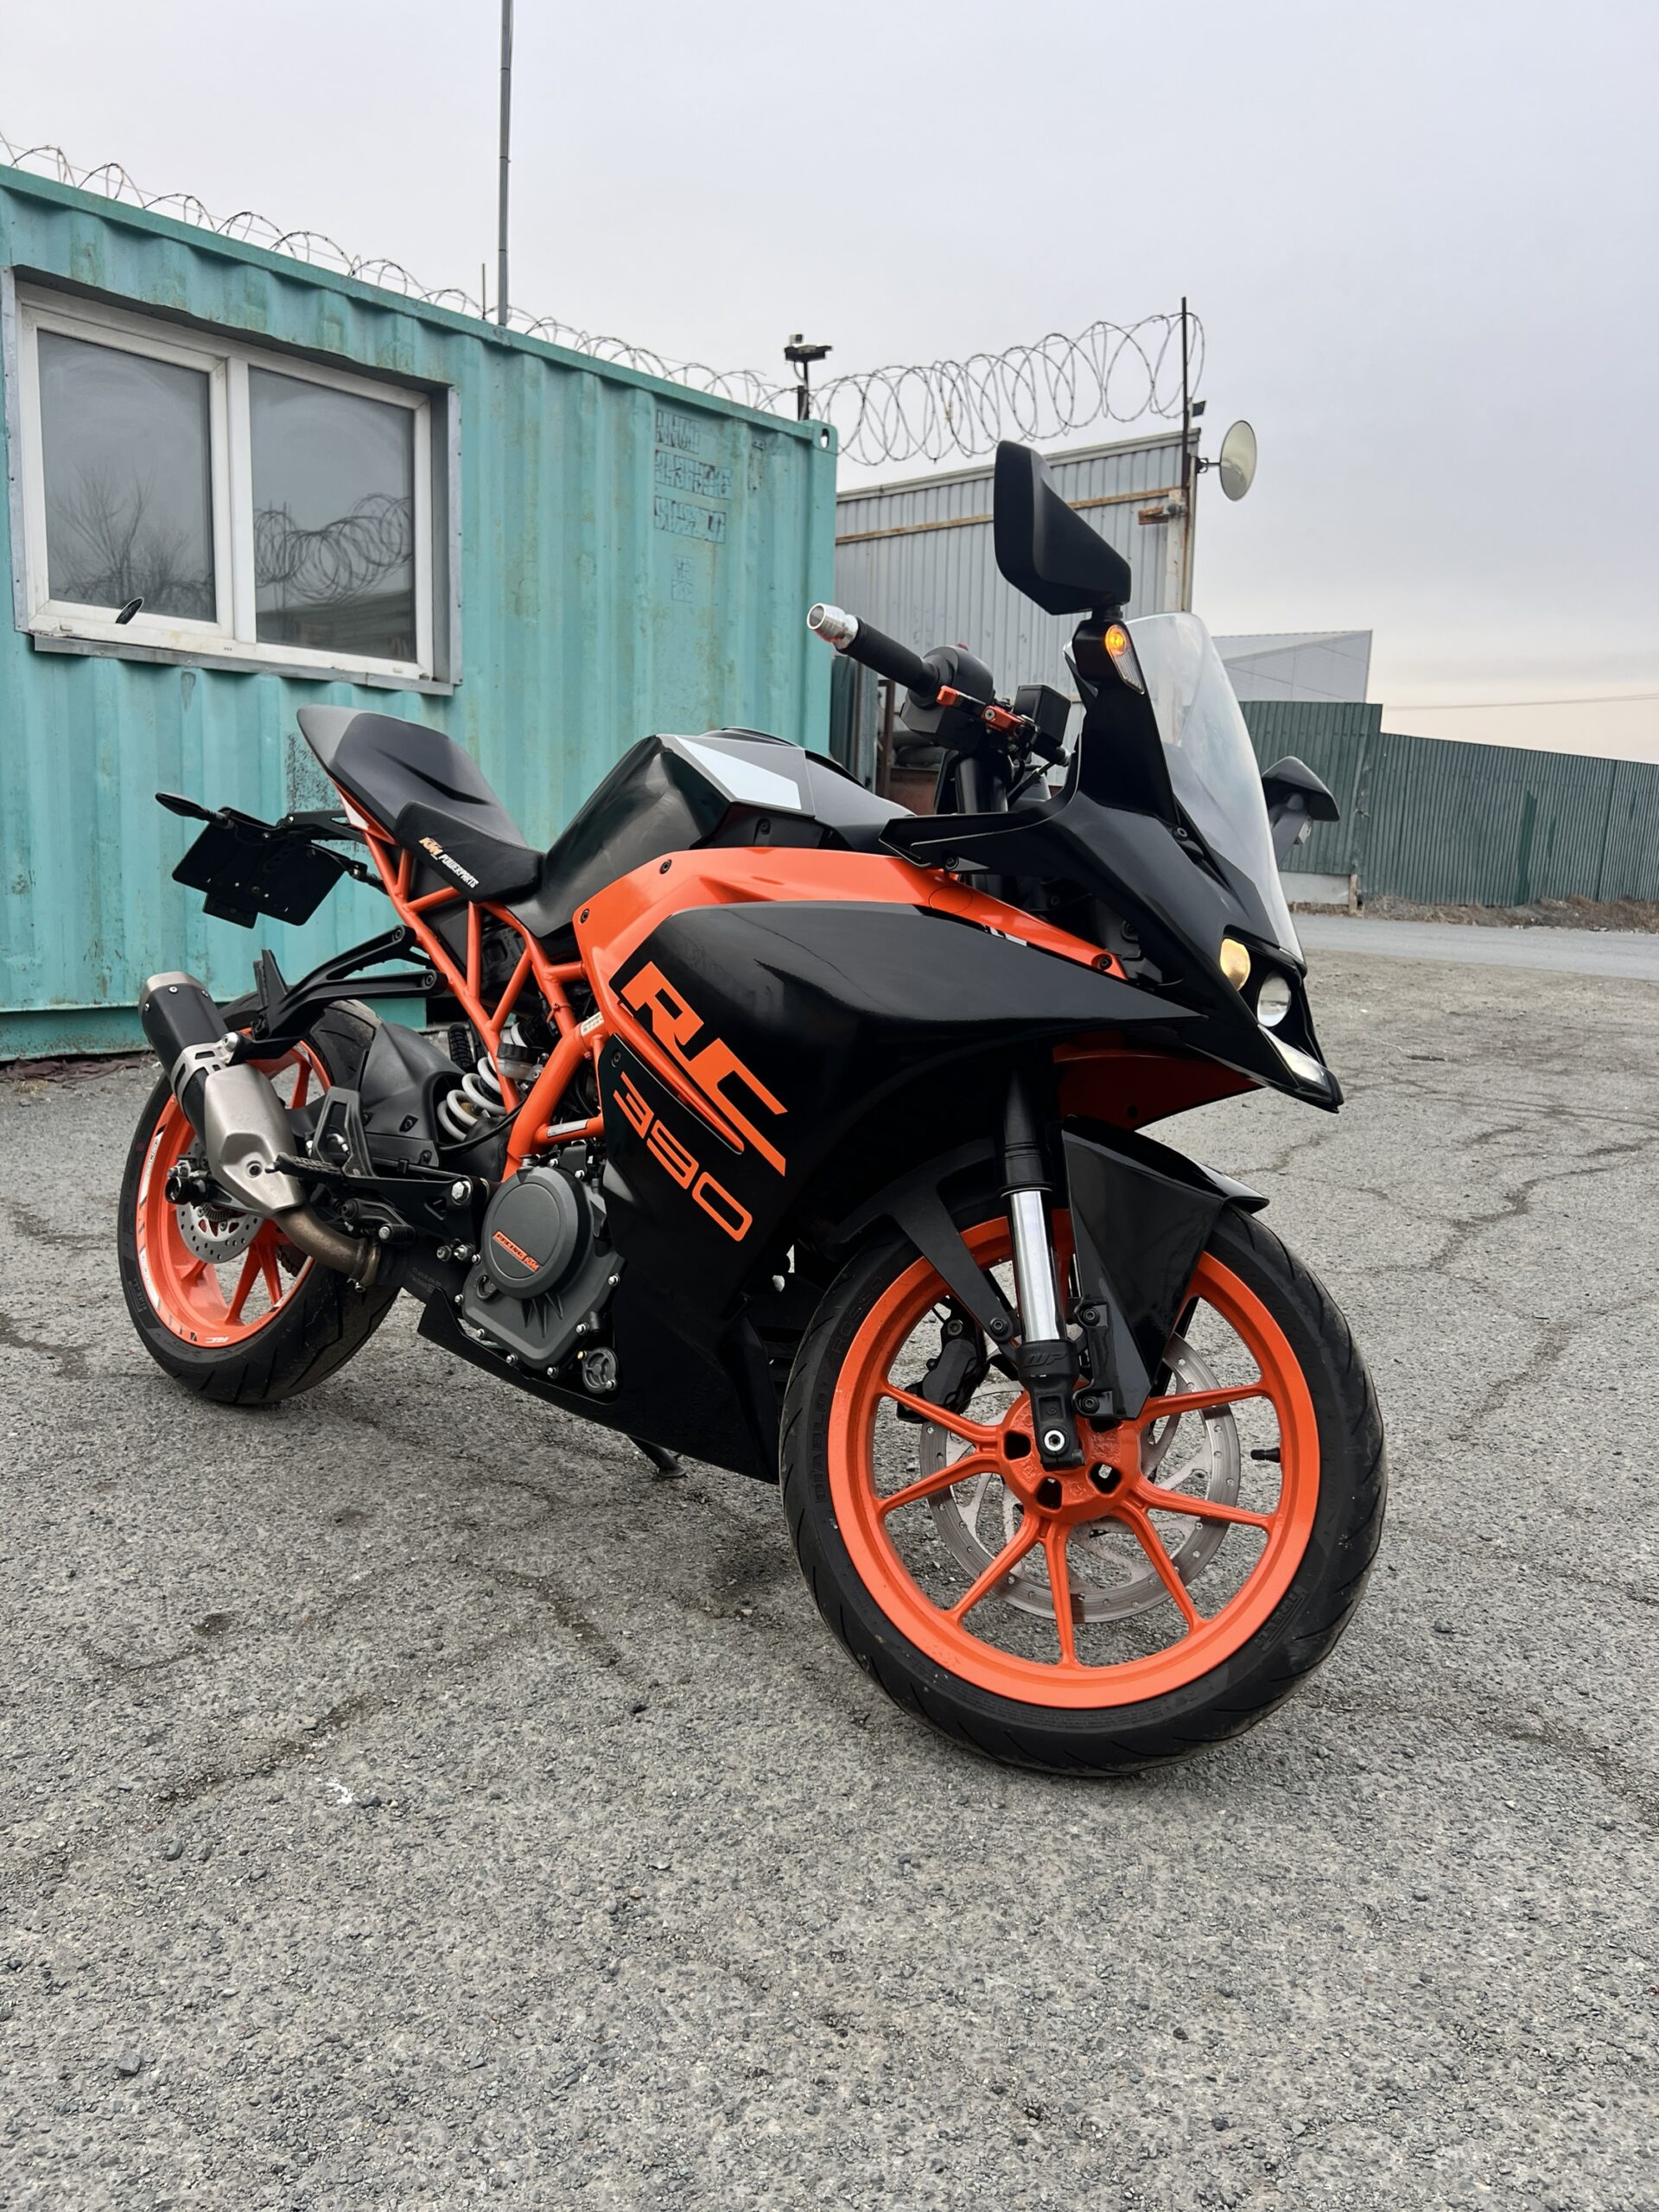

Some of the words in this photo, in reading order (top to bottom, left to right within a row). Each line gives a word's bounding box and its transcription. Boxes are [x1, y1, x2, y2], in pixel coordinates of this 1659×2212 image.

[438, 854, 480, 888] POWERPARTS
[620, 961, 788, 1177] RC
[613, 1071, 753, 1242] 390
[1023, 1352, 1068, 1369] WP
[812, 1393, 828, 1503] DIABLO
